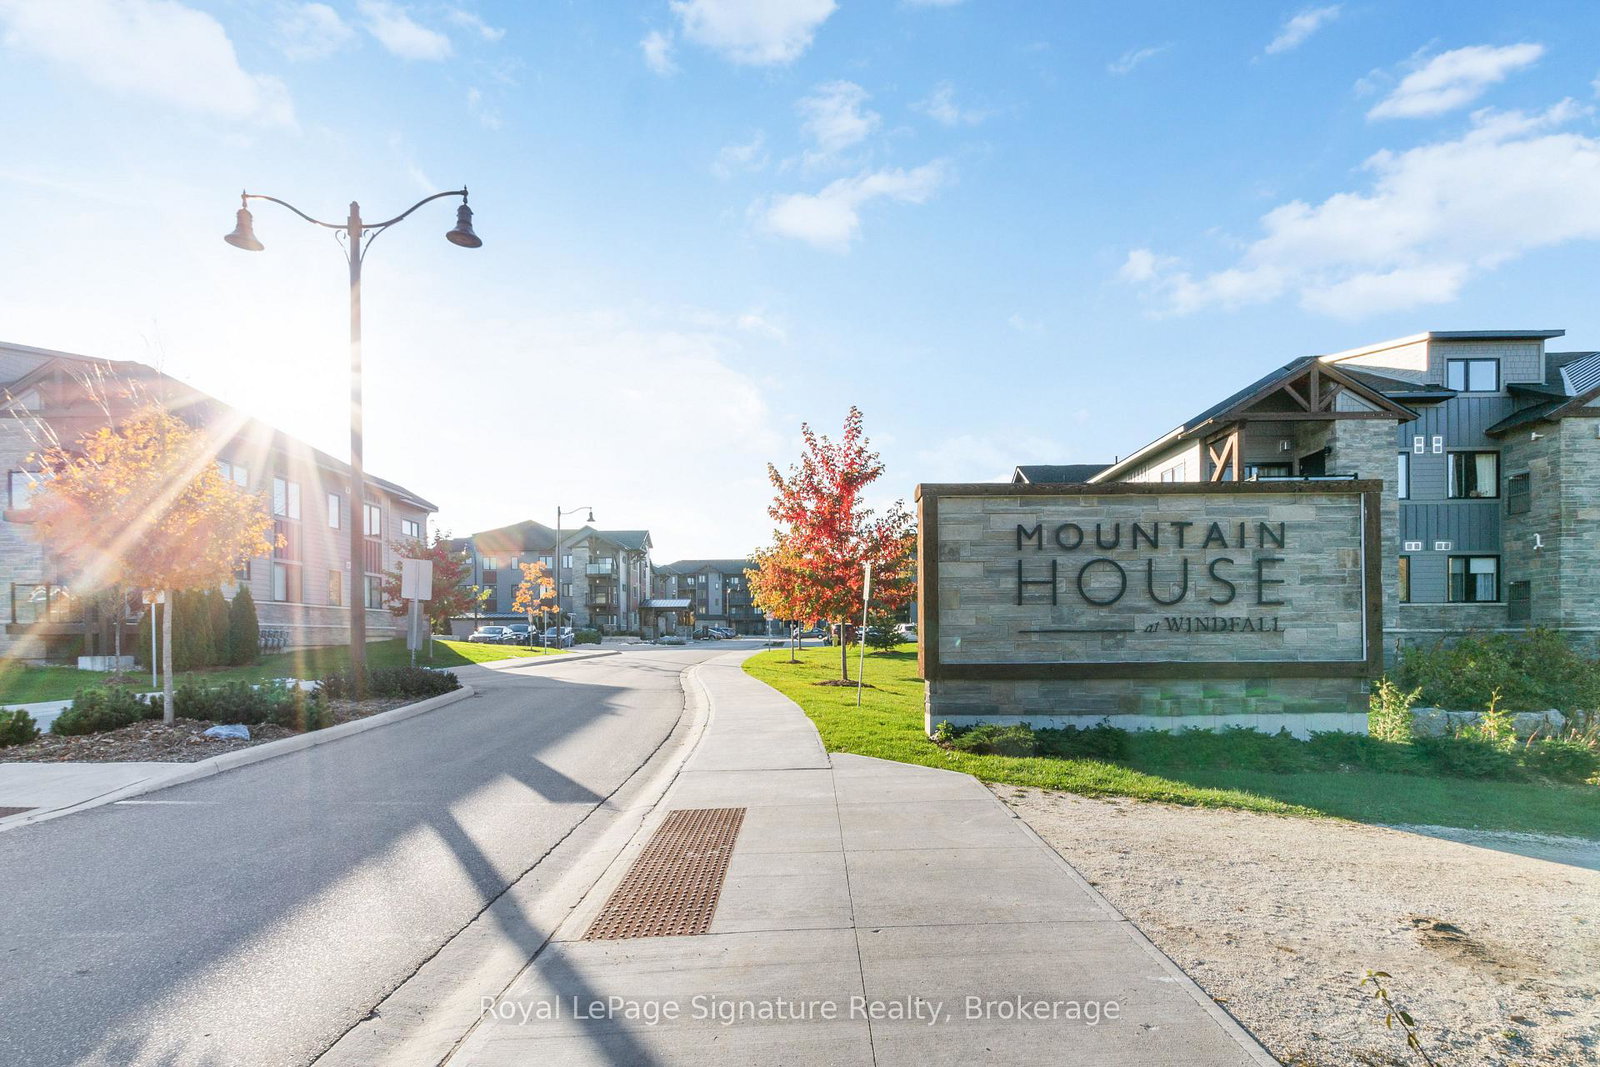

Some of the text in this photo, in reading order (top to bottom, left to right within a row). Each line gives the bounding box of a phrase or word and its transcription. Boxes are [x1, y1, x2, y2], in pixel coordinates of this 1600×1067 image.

[1017, 521, 1286, 551] MOUNTAIN
[1017, 557, 1286, 606] HOUSE
[1143, 616, 1286, 634] at WINDFALL
